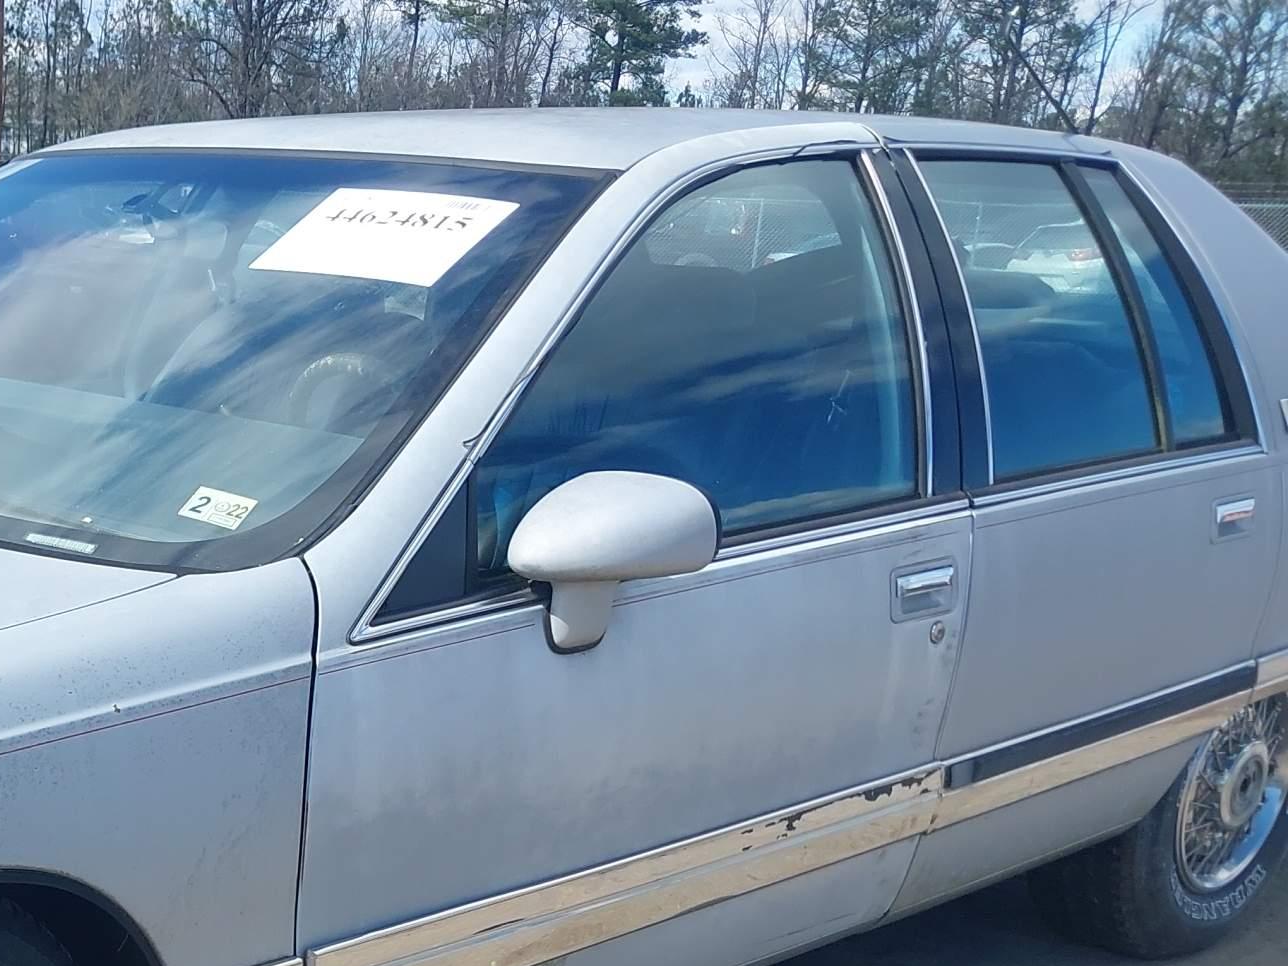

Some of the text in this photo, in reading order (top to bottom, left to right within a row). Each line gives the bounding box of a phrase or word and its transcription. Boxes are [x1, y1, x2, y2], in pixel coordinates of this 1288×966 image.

[326, 208, 473, 231] 44624815
[188, 496, 249, 519] 2 22
